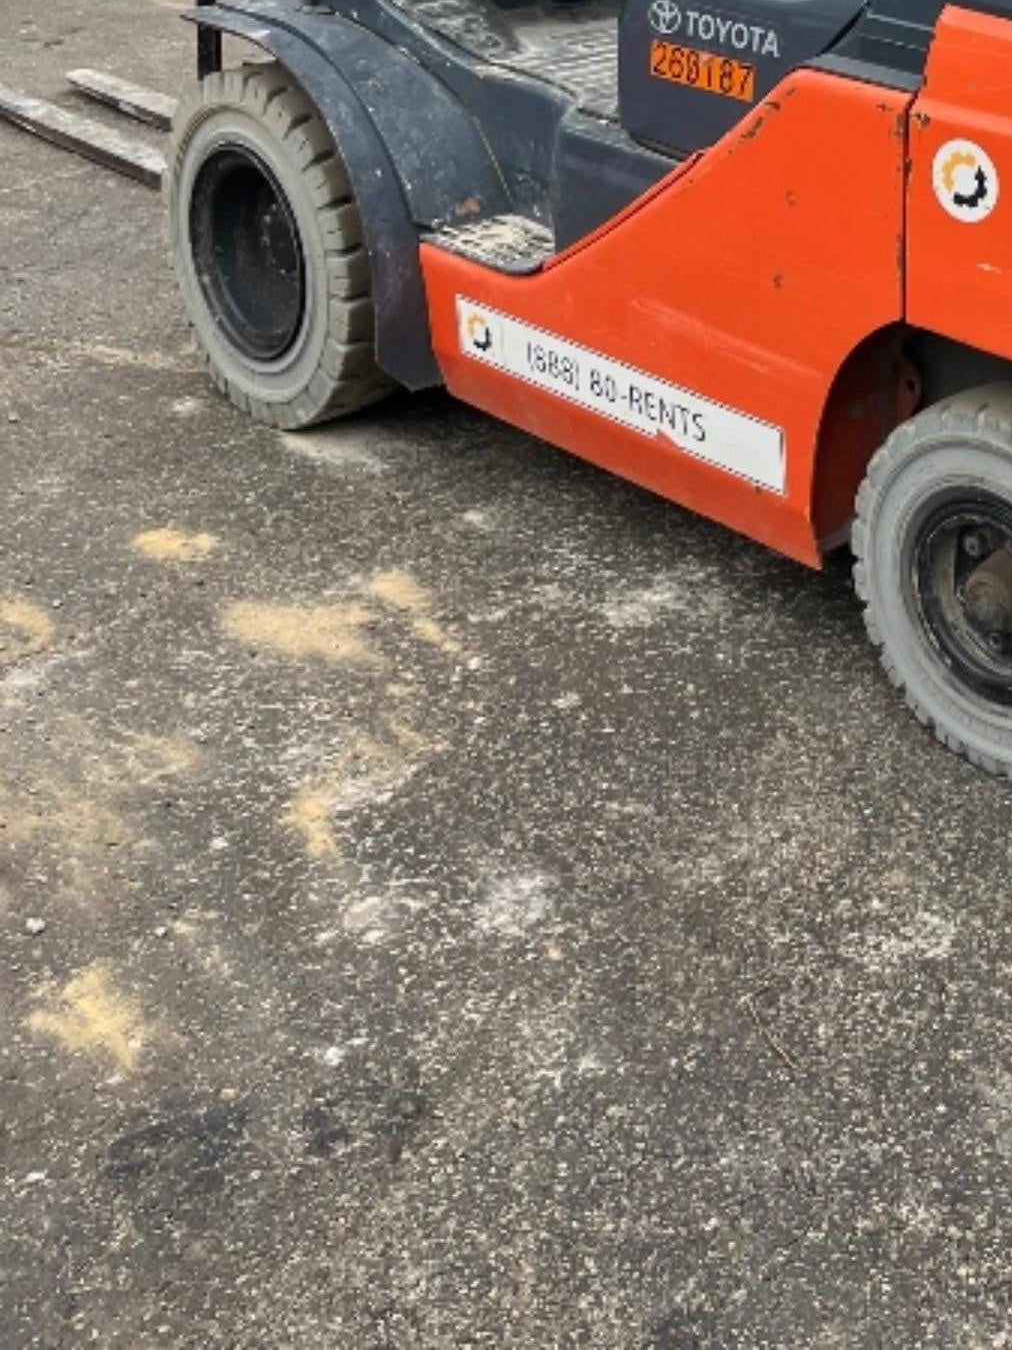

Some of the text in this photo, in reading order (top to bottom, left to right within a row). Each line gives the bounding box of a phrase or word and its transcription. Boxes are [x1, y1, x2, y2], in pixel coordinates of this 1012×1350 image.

[685, 10, 781, 58] TOYOTA
[526, 341, 706, 442] (888) 80-RENTS
